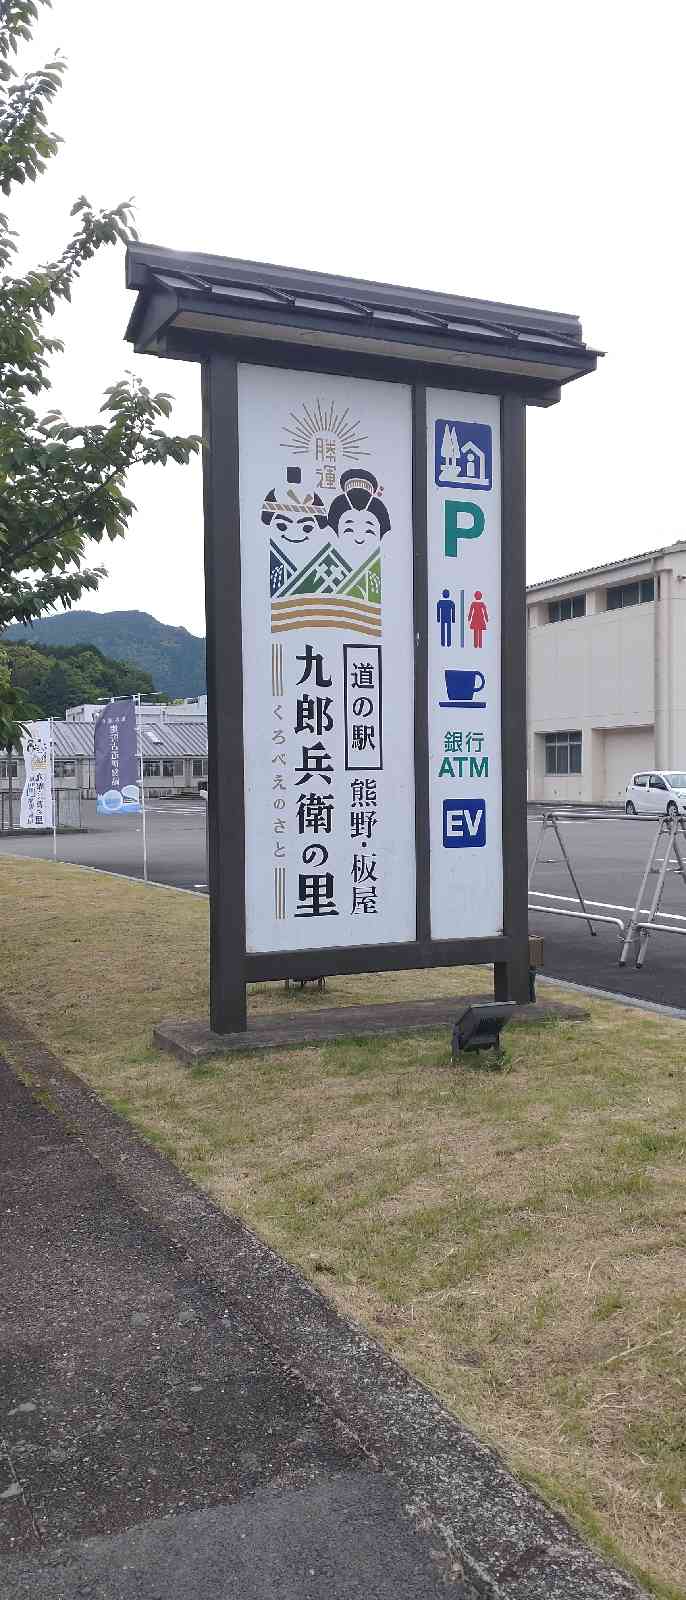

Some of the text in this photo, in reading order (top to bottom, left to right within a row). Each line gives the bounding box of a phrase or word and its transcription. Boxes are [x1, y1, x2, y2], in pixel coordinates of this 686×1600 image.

[315, 438, 337, 489] 勝運
[444, 499, 486, 557] P
[350, 662, 376, 752] 道の駅
[438, 756, 489, 777] ATM
[444, 731, 484, 752] 銀行
[271, 704, 287, 858] くろべえのさと
[293, 644, 340, 918] 九郎兵衛の里
[350, 777, 379, 916] 熊野・板屋
[446, 809, 483, 837] EV
